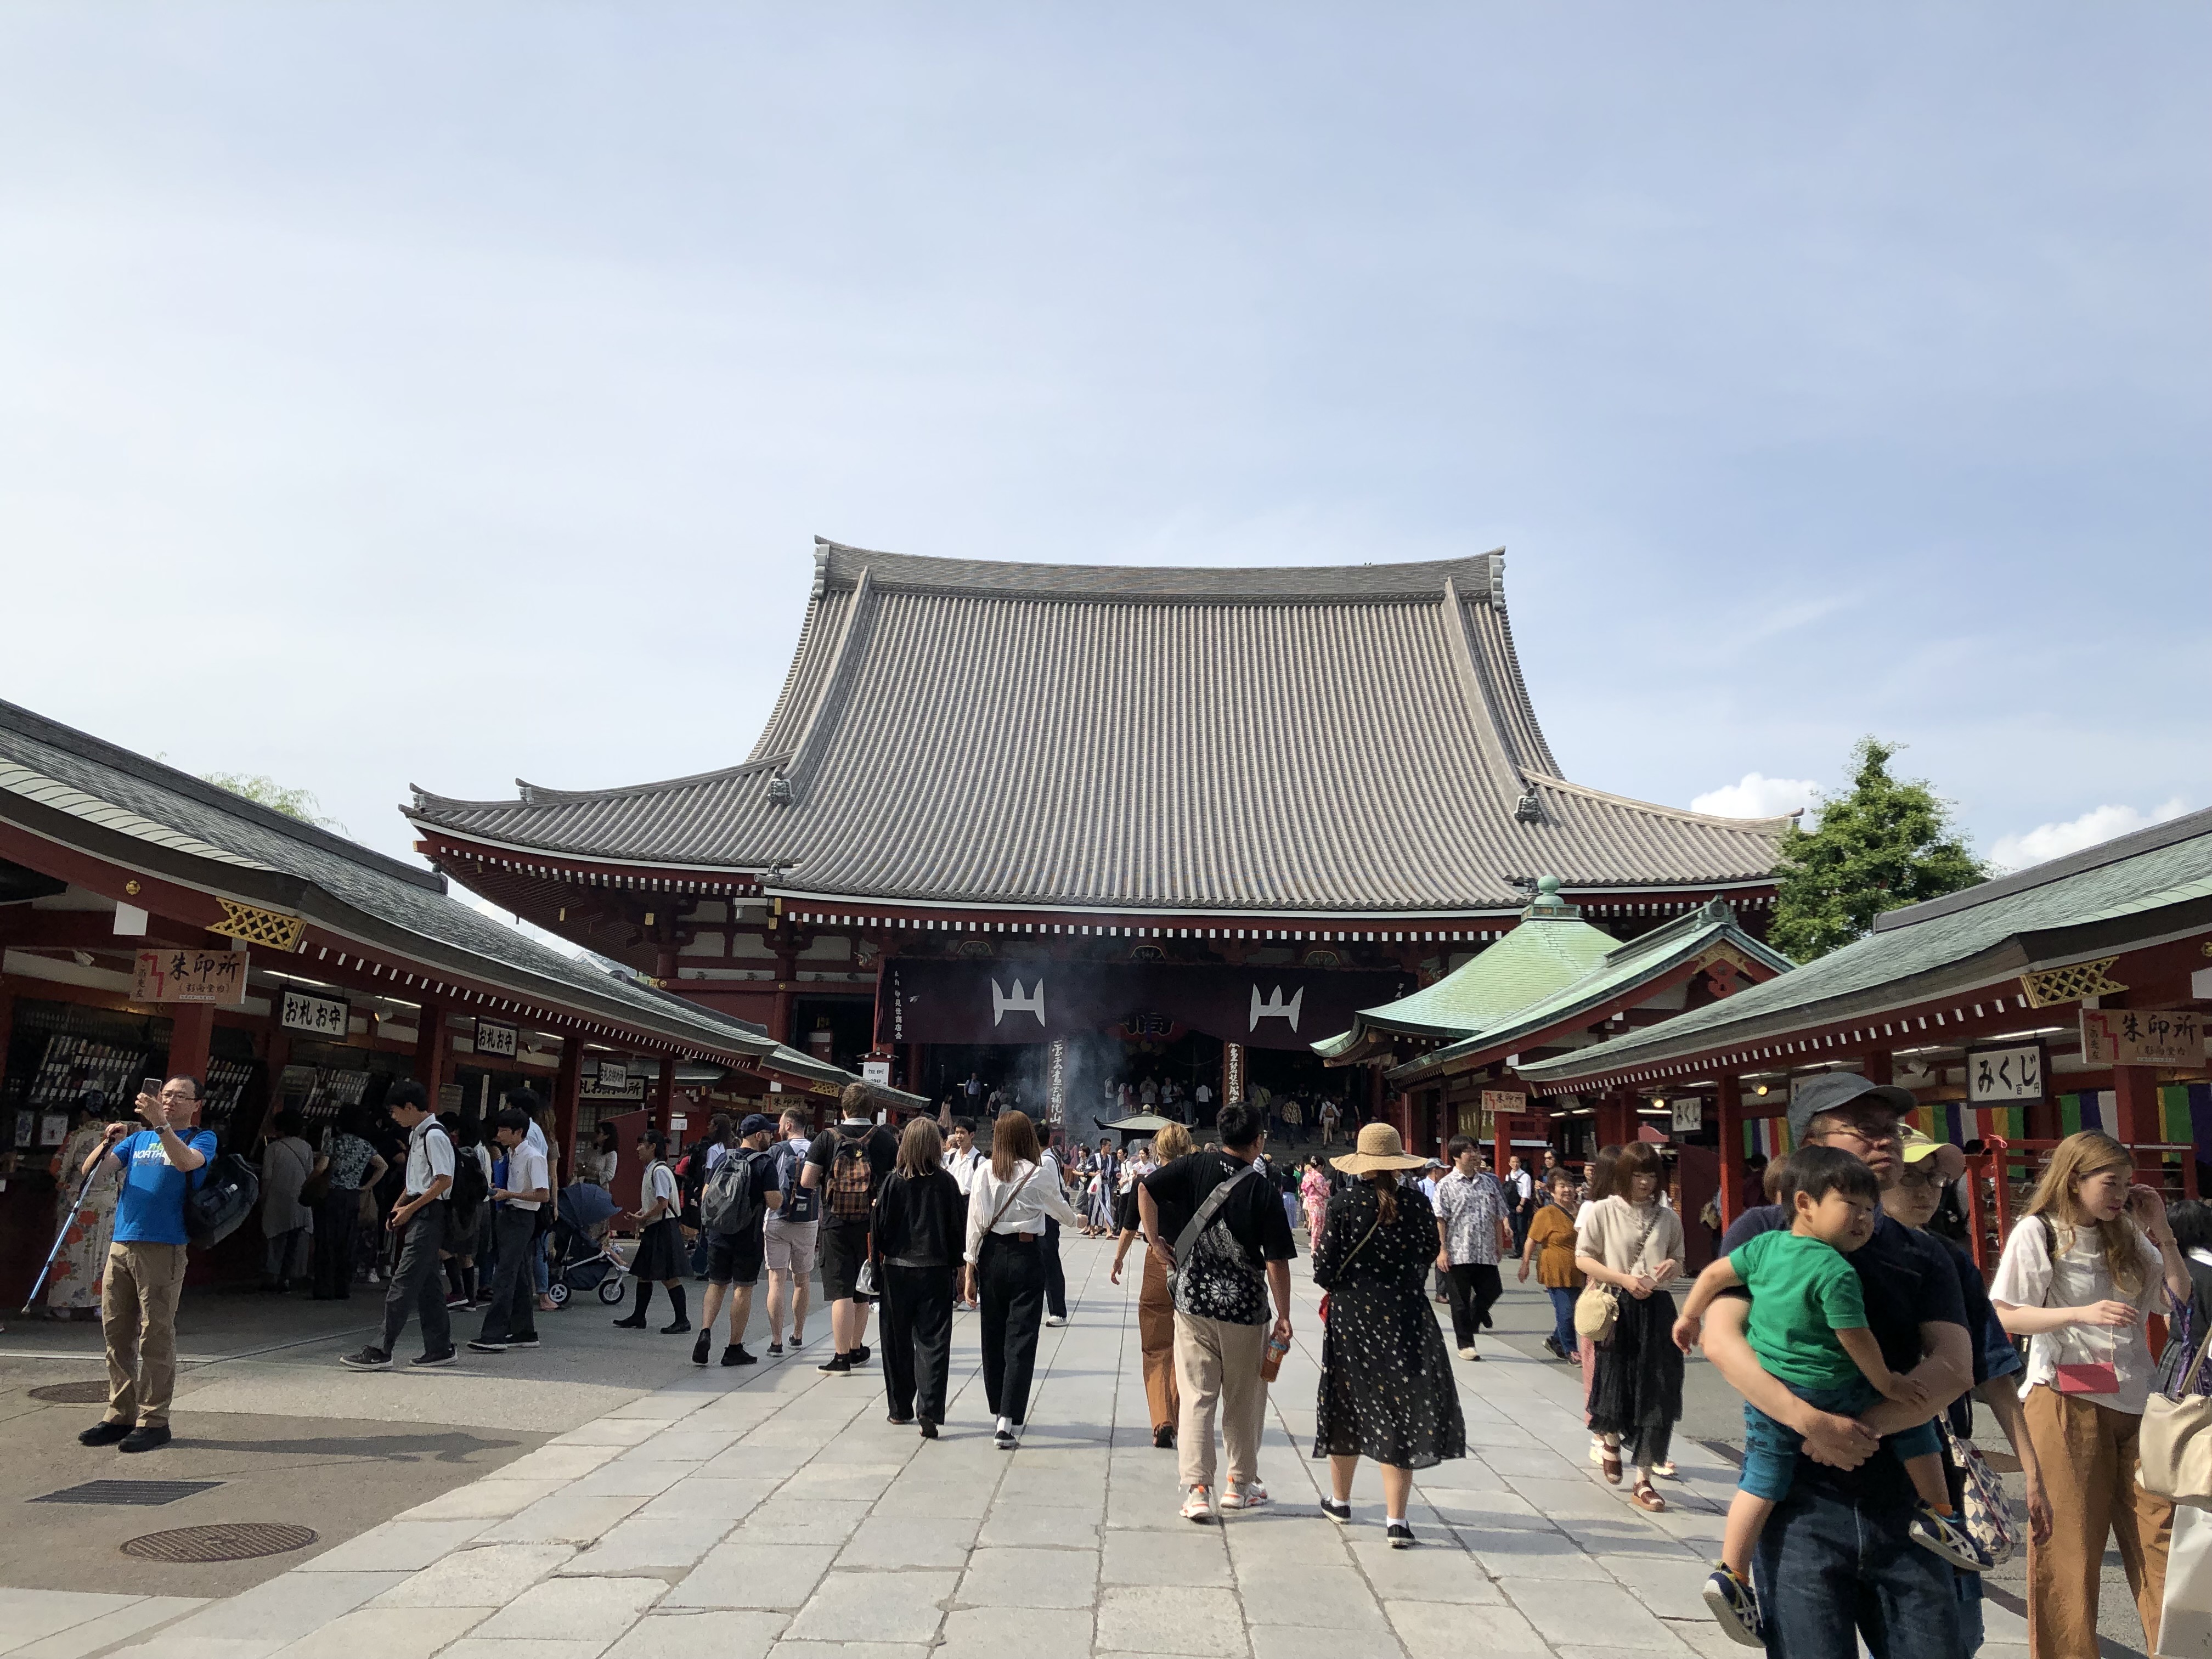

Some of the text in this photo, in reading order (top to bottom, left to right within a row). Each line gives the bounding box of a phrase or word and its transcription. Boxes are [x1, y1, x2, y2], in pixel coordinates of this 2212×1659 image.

[170, 952, 240, 983] 朱印所
[285, 997, 341, 1031] お札お守
[2123, 1013, 2197, 1045] 朱印所
[478, 1026, 512, 1052] お札お守
[1978, 1054, 2036, 1093] みくじ
[133, 1149, 163, 1159] NORTH
